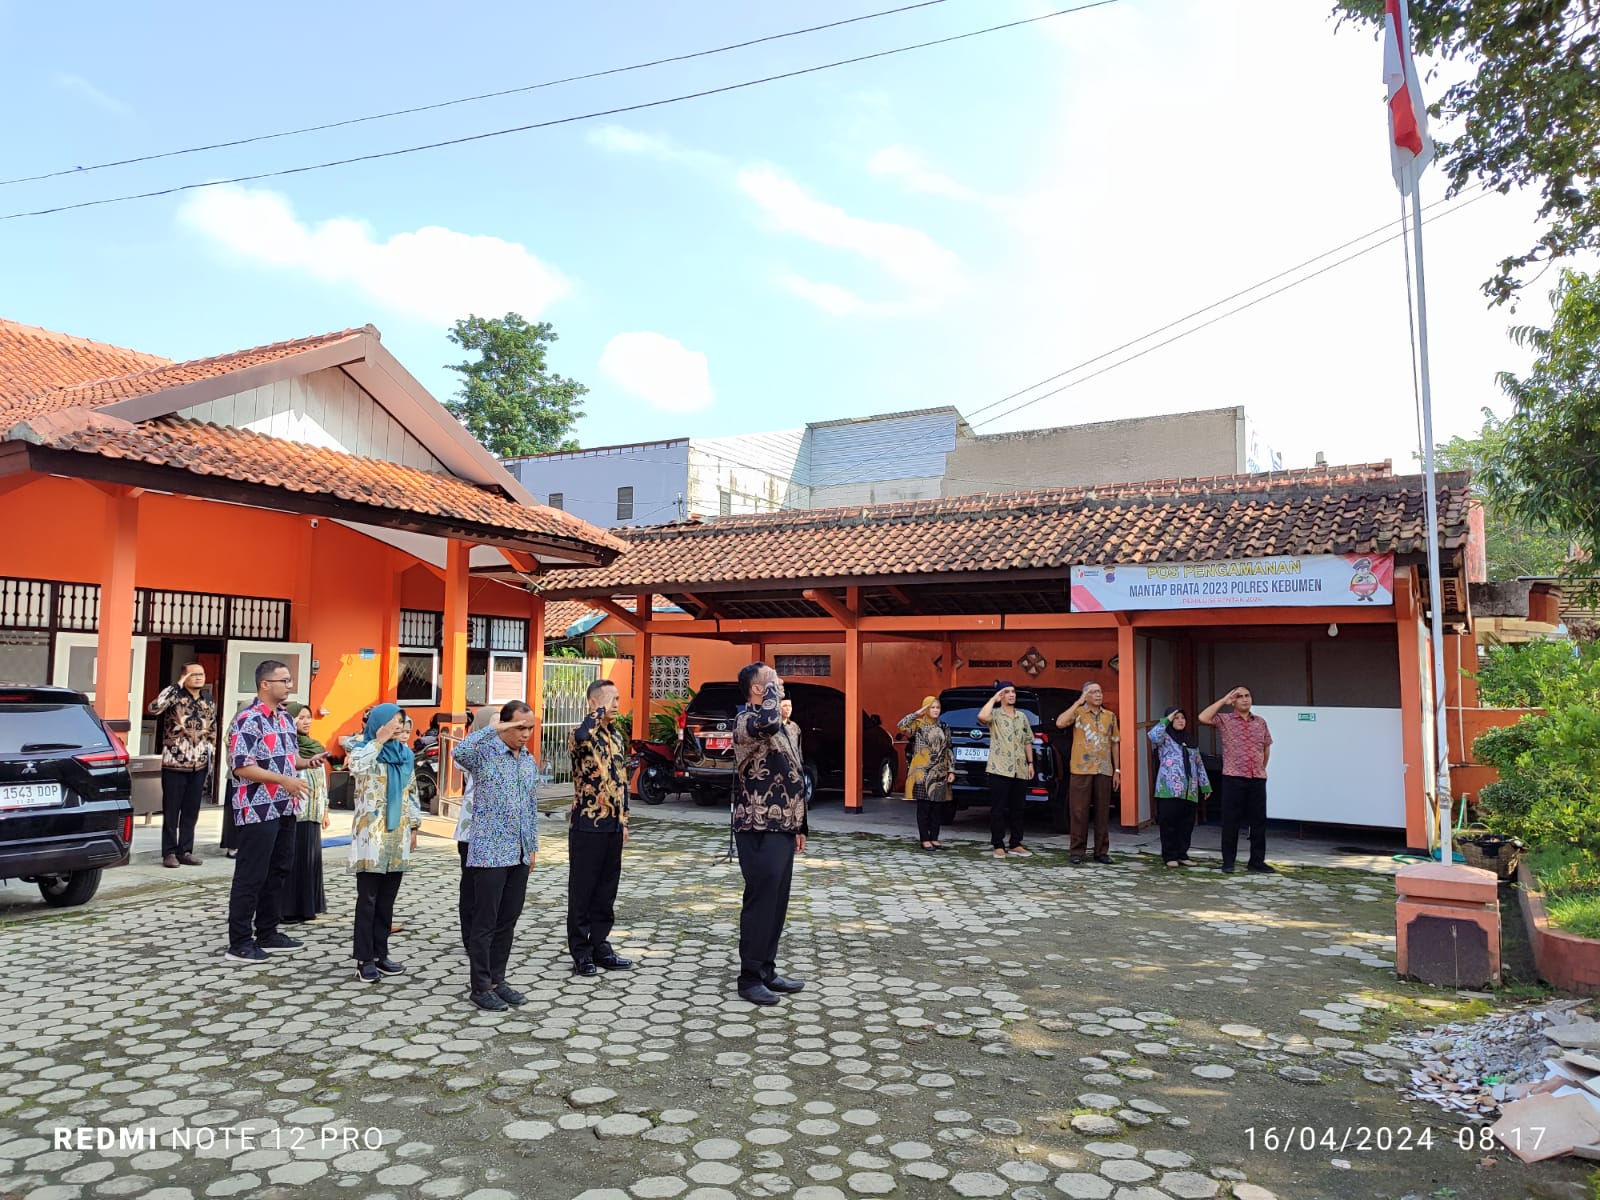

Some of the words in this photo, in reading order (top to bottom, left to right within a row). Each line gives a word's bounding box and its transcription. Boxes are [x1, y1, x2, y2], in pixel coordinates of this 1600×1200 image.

[1147, 566, 1179, 579] POS
[1184, 560, 1301, 578] PENGAMANAN
[1129, 584, 1168, 597] MANTAP
[1170, 582, 1199, 595] BRATA
[1203, 581, 1228, 595] 2023
[1231, 580, 1269, 594] POLRES
[1272, 578, 1322, 593] KEBUMEN
[3, 786, 33, 800] 1543
[37, 785, 58, 797] DOP
